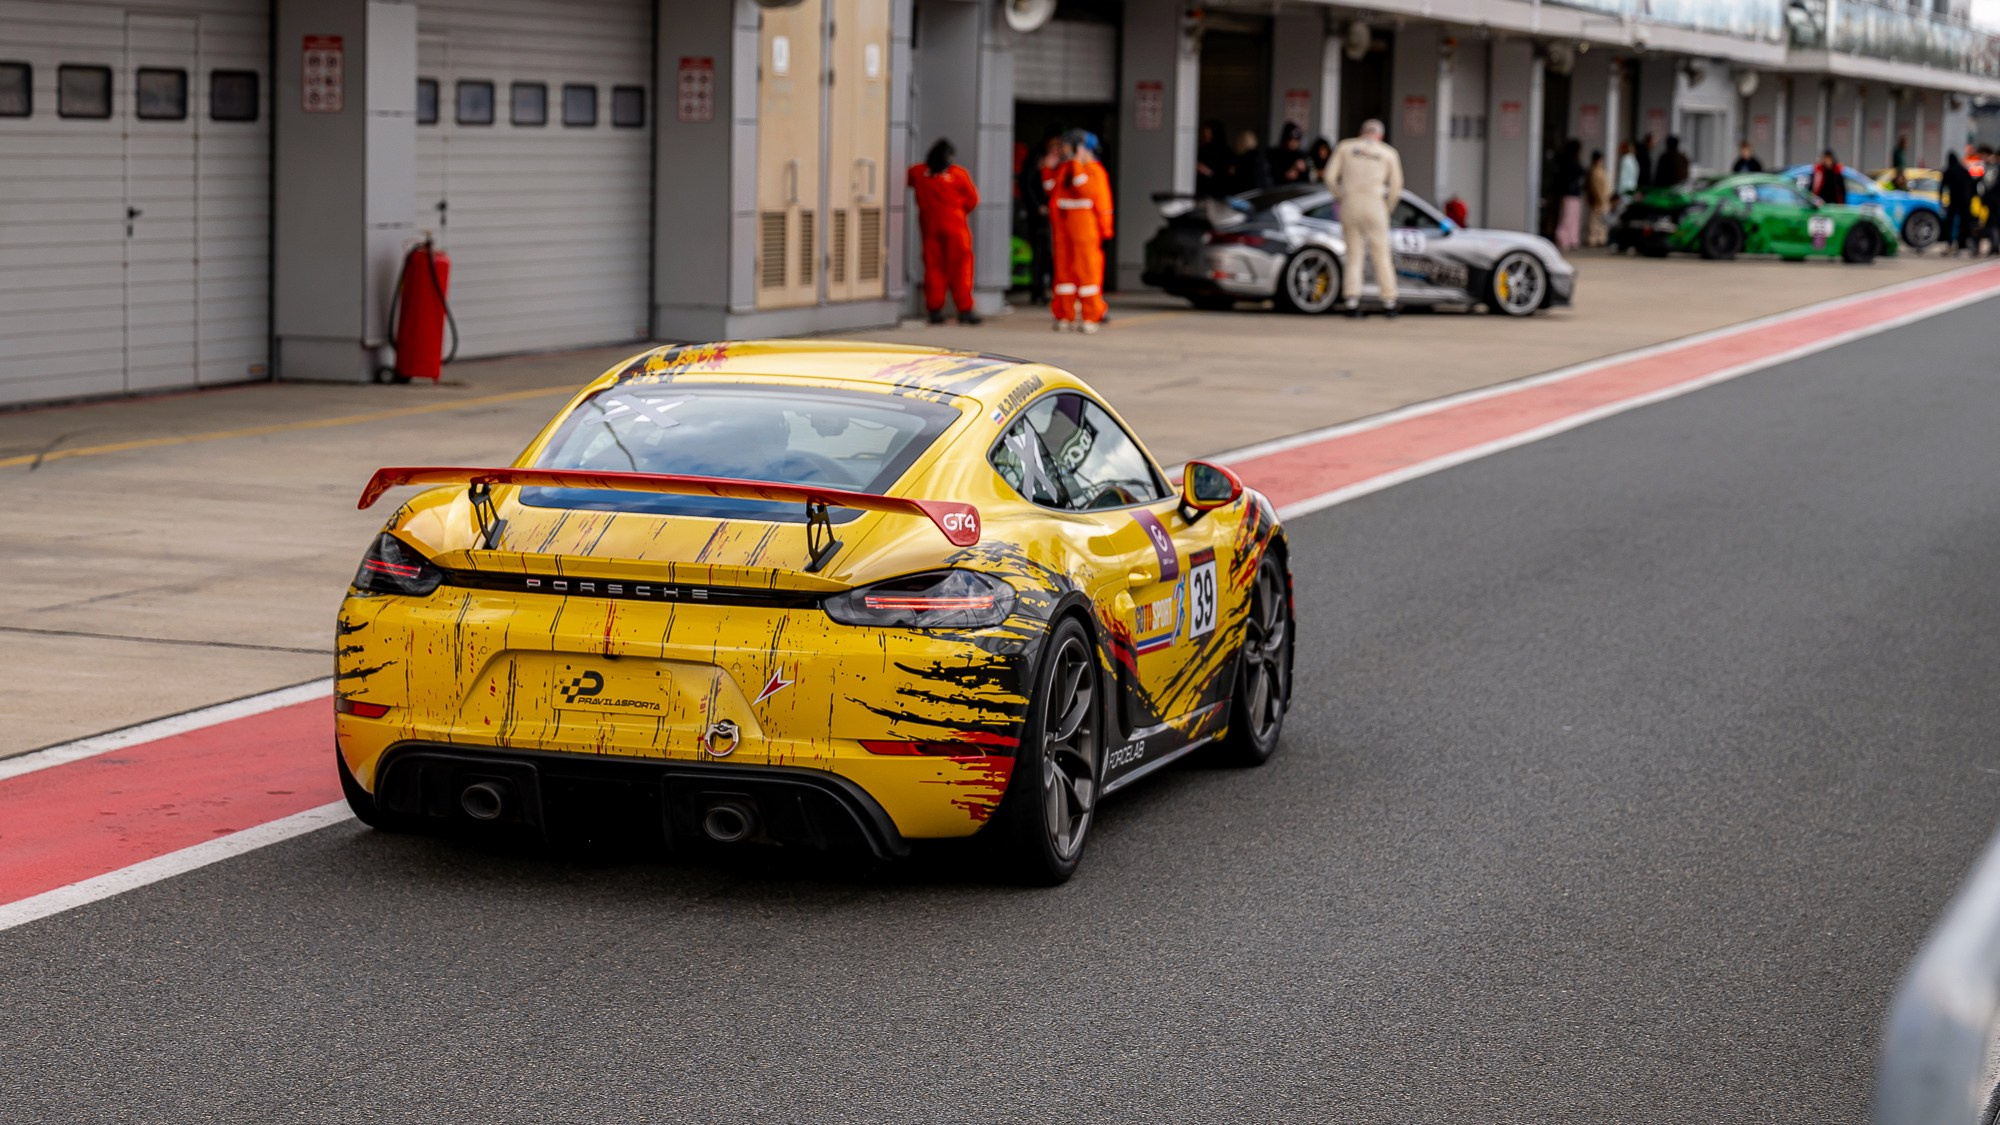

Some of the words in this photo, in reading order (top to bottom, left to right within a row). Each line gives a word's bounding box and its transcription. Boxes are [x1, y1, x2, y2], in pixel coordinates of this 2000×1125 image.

[942, 512, 976, 533] GT4
[526, 579, 708, 599] PORSCHE
[1194, 569, 1213, 631] 39
[577, 697, 661, 711] PRAVILASPORTA
[1110, 740, 1145, 769] FORCELAB
